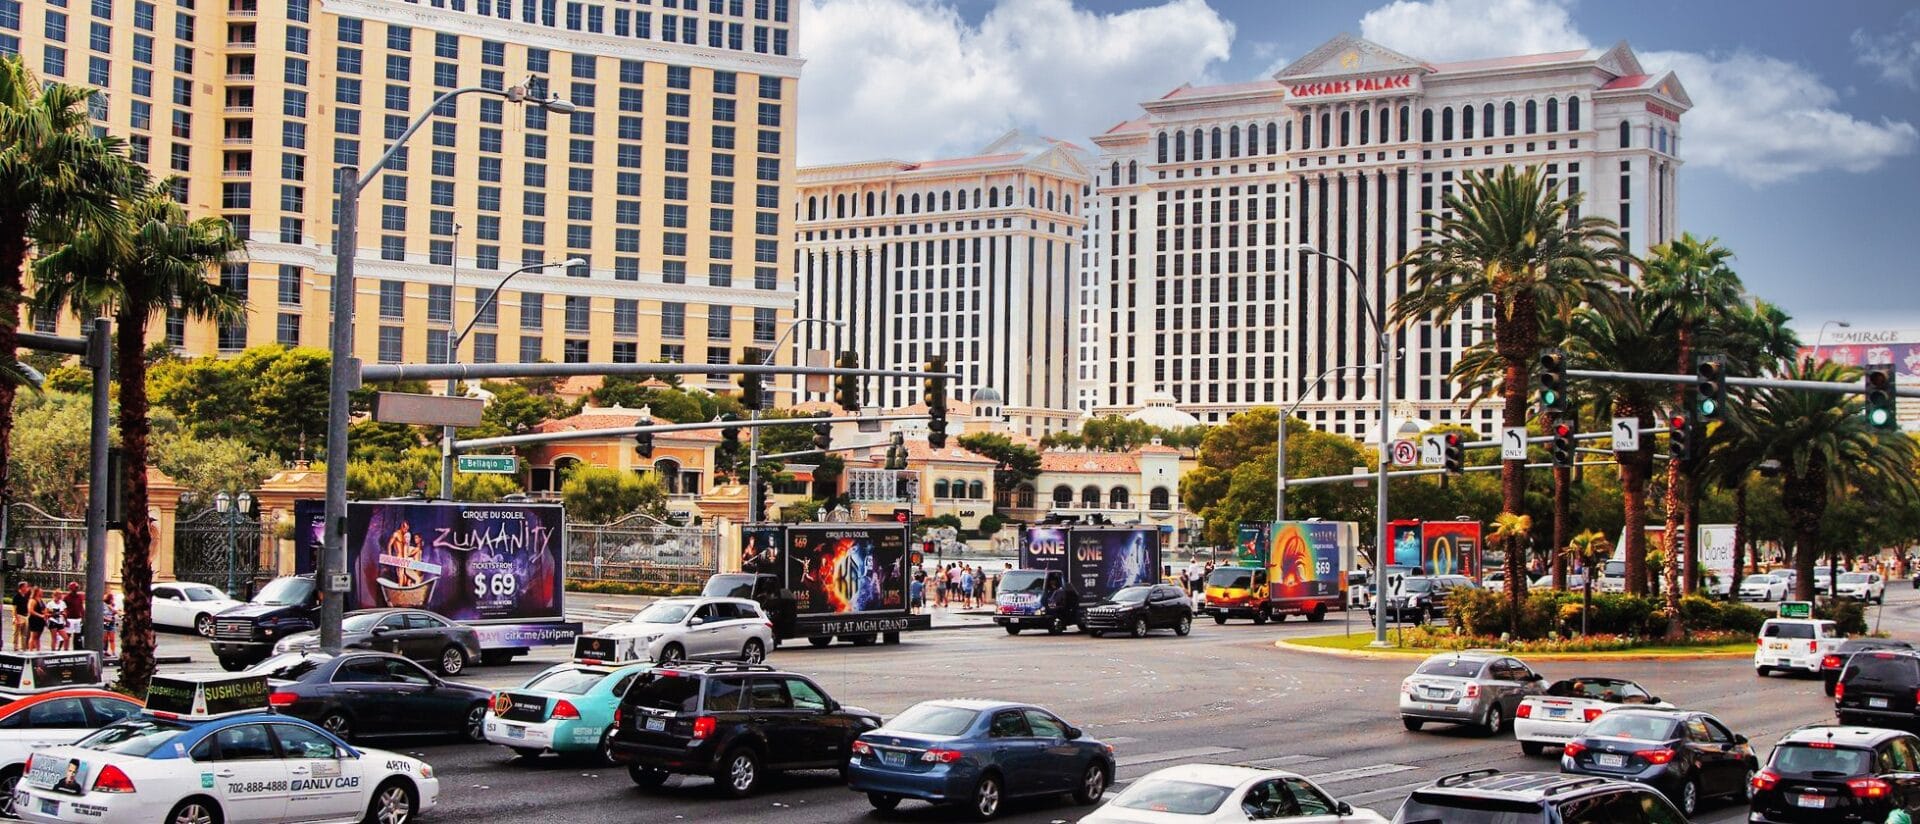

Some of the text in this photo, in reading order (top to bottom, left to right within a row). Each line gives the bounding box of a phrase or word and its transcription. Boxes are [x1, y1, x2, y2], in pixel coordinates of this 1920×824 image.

[1291, 75, 1411, 98] CAESARS PALACE
[1845, 330, 1898, 342] MIRAGE
[1615, 440, 1635, 449] ONLY
[1504, 449, 1523, 457] ONLY
[467, 459, 498, 469] Bellagio
[1425, 456, 1442, 464] ONLY
[462, 510, 525, 521] CIRQUE DU SOLEIL
[825, 531, 844, 539] CIRQUE
[433, 520, 555, 563] ZUMANITY
[1029, 540, 1065, 555] ONE
[1077, 545, 1103, 561] ONE
[1315, 561, 1331, 575] $69
[822, 618, 908, 634] LIVE AT MGM GRAND
[504, 629, 575, 641] cirk.me/stripme
[205, 681, 267, 701] SUSHISAMBA
[385, 760, 411, 772] 4870
[227, 781, 288, 794] 702-888-4888
[301, 776, 359, 790] ANLV CAB
